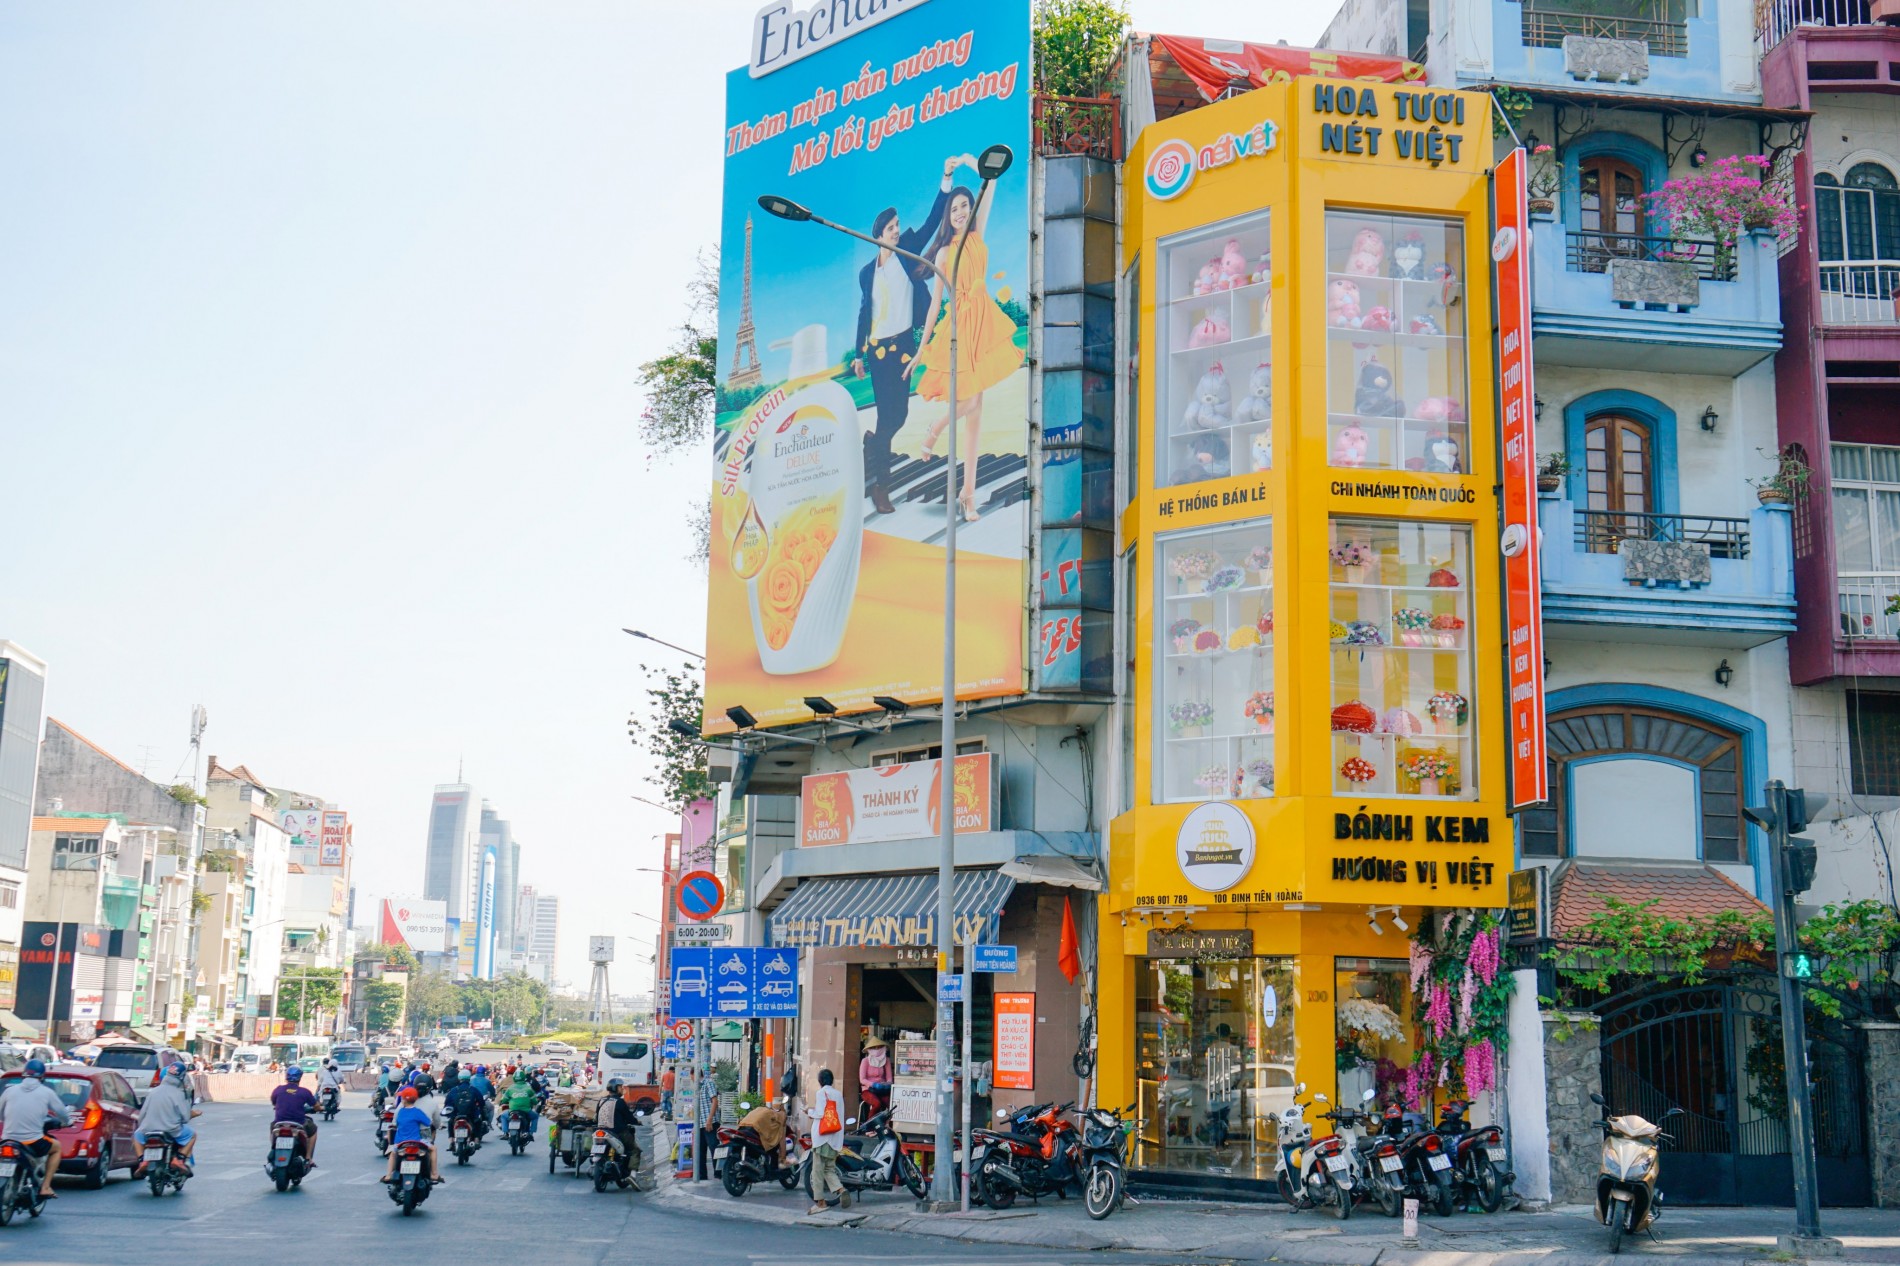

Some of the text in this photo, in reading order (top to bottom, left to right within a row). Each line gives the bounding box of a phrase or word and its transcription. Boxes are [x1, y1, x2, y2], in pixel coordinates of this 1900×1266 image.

[727, 31, 973, 156] Thơm mịn vấn vương
[1314, 83, 1465, 125] HOA TƯƠI
[789, 62, 1018, 175] Mở lối yêu thương
[1321, 120, 1464, 167] NÉT VIỆT
[1504, 328, 1519, 357] HOA
[1506, 397, 1521, 426] NÉT
[721, 389, 786, 497] Silk Protein
[774, 432, 833, 458] Enchanteur
[1506, 432, 1523, 461] VIỆT
[787, 449, 820, 469] DELUXE
[1159, 482, 1266, 517] HỆ THỐNG BÁN LẺ
[1331, 481, 1475, 503] CHI NHÁNH TOÀN QUỐC
[863, 785, 919, 808] THÀNH KÝ
[956, 806, 968, 815] BIA
[324, 825, 344, 835] HOÀI
[807, 828, 840, 842] SAIGON
[818, 820, 829, 828] BIA
[1334, 805, 1489, 843] BÁNH KEM
[324, 837, 342, 845] ANH
[326, 848, 338, 857] 14
[1195, 853, 1233, 863] Banhngot.vn
[1332, 856, 1494, 890] HƯƠNG VỊ VIỆT
[1136, 895, 1188, 905] 0936 901 789
[1214, 888, 1303, 903] 100 ĐINH TIÊN HOÀNG
[984, 948, 1008, 957] ĐƯỜNG
